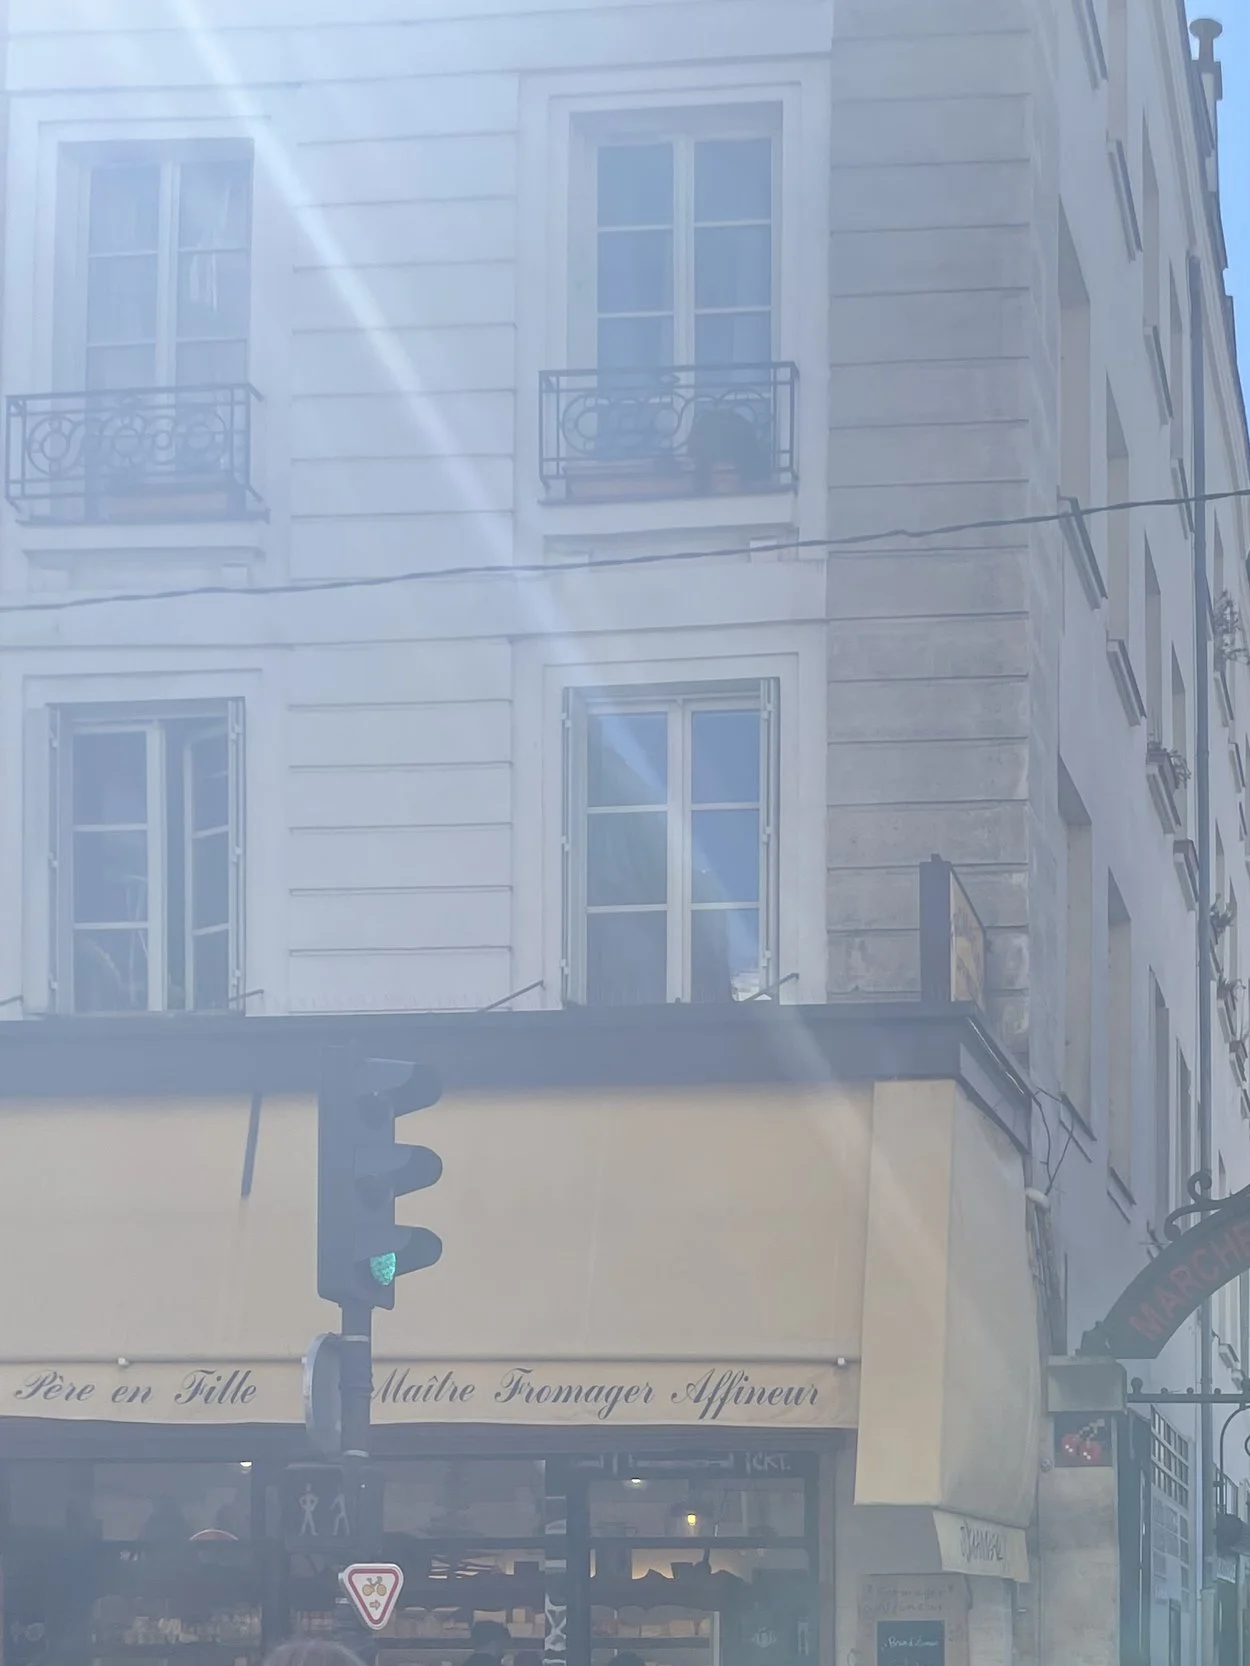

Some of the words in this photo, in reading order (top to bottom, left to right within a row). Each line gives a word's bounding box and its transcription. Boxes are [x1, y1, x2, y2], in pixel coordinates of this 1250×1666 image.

[14, 1368, 96, 1402] Père
[110, 1384, 154, 1405] en
[174, 1367, 258, 1406] Fille
[371, 1368, 475, 1405] Maître
[493, 1367, 655, 1421] Fromager
[670, 1368, 819, 1421] Affineur
